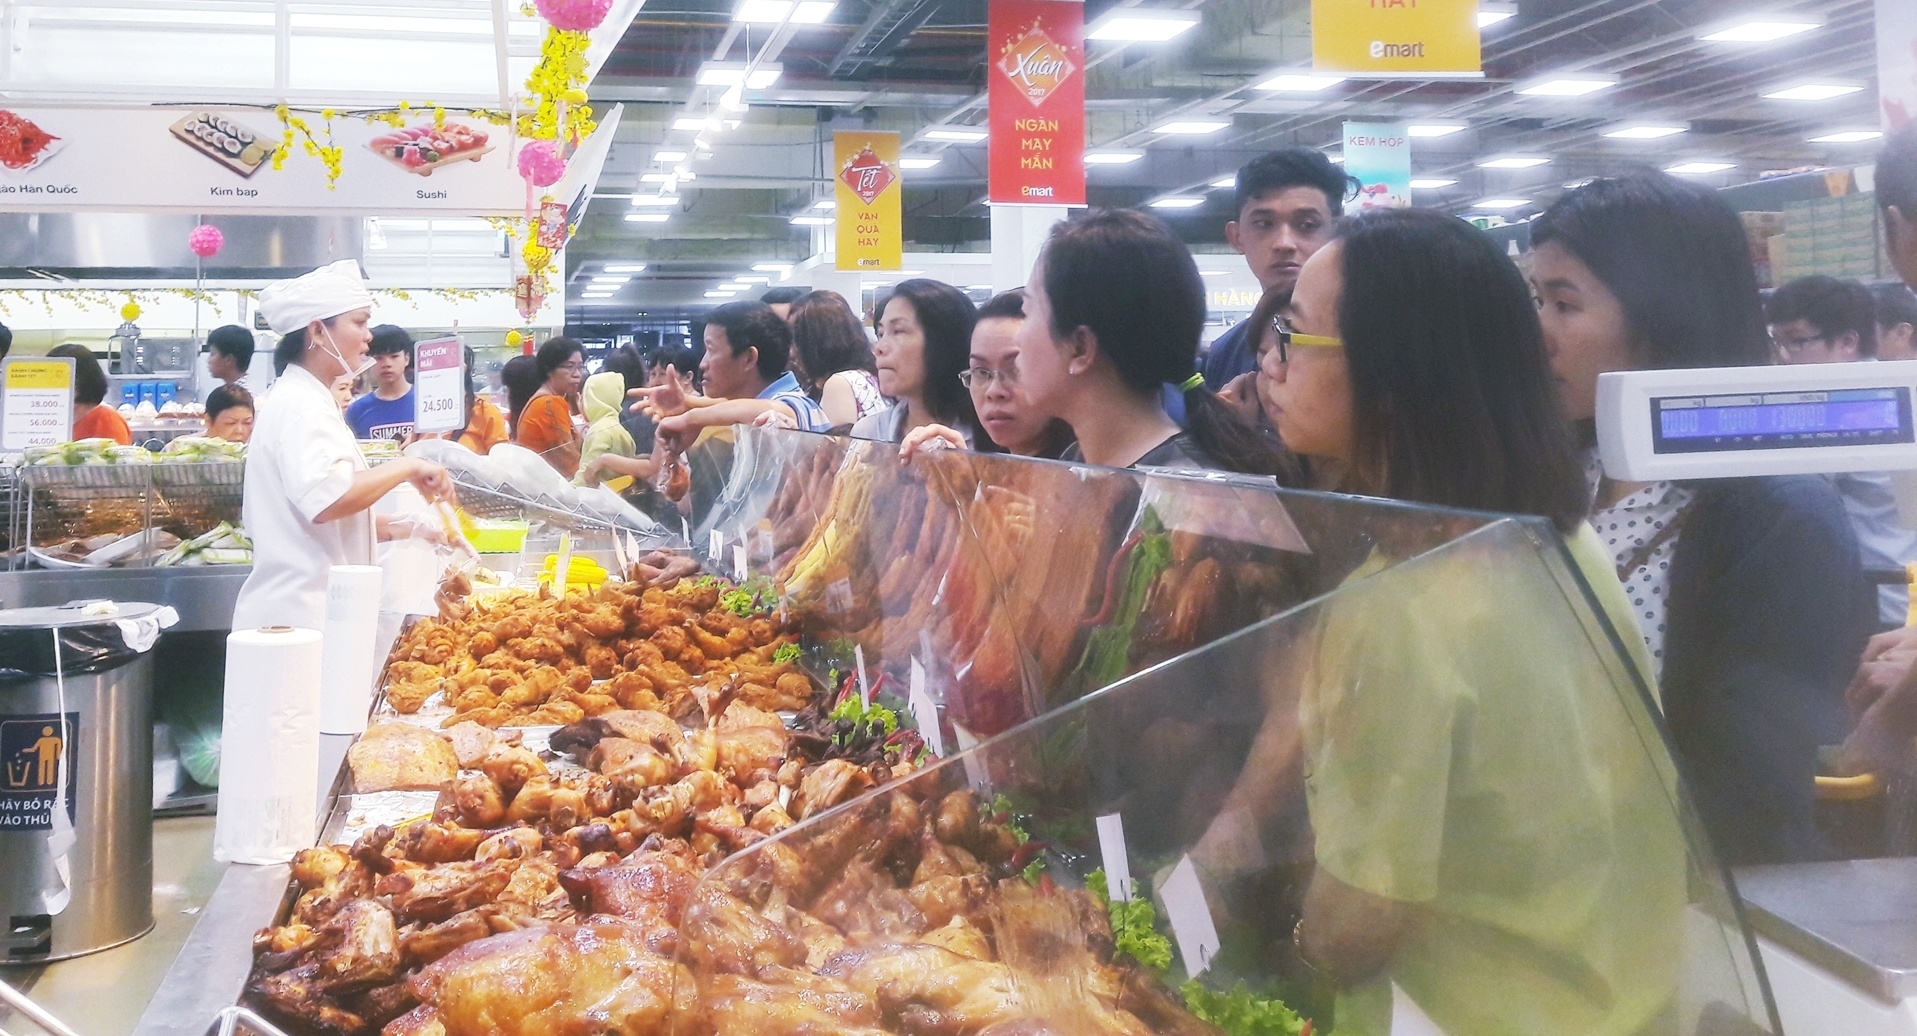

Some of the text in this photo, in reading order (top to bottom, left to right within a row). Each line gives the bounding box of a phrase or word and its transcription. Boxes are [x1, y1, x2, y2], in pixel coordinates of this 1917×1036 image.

[1370, 40, 1425, 58] emart
[1028, 87, 1045, 97] 2017
[1021, 138, 1053, 151] MAY
[1349, 136, 1376, 147] KEM
[46, 183, 79, 194] Quốc
[210, 187, 233, 197] Kim
[416, 189, 447, 199] Sushi
[1021, 185, 1054, 197] emart
[858, 237, 879, 247] HAY
[857, 258, 880, 266] emart
[423, 398, 453, 413] 24.500
[23, 797, 41, 811] BỎ
